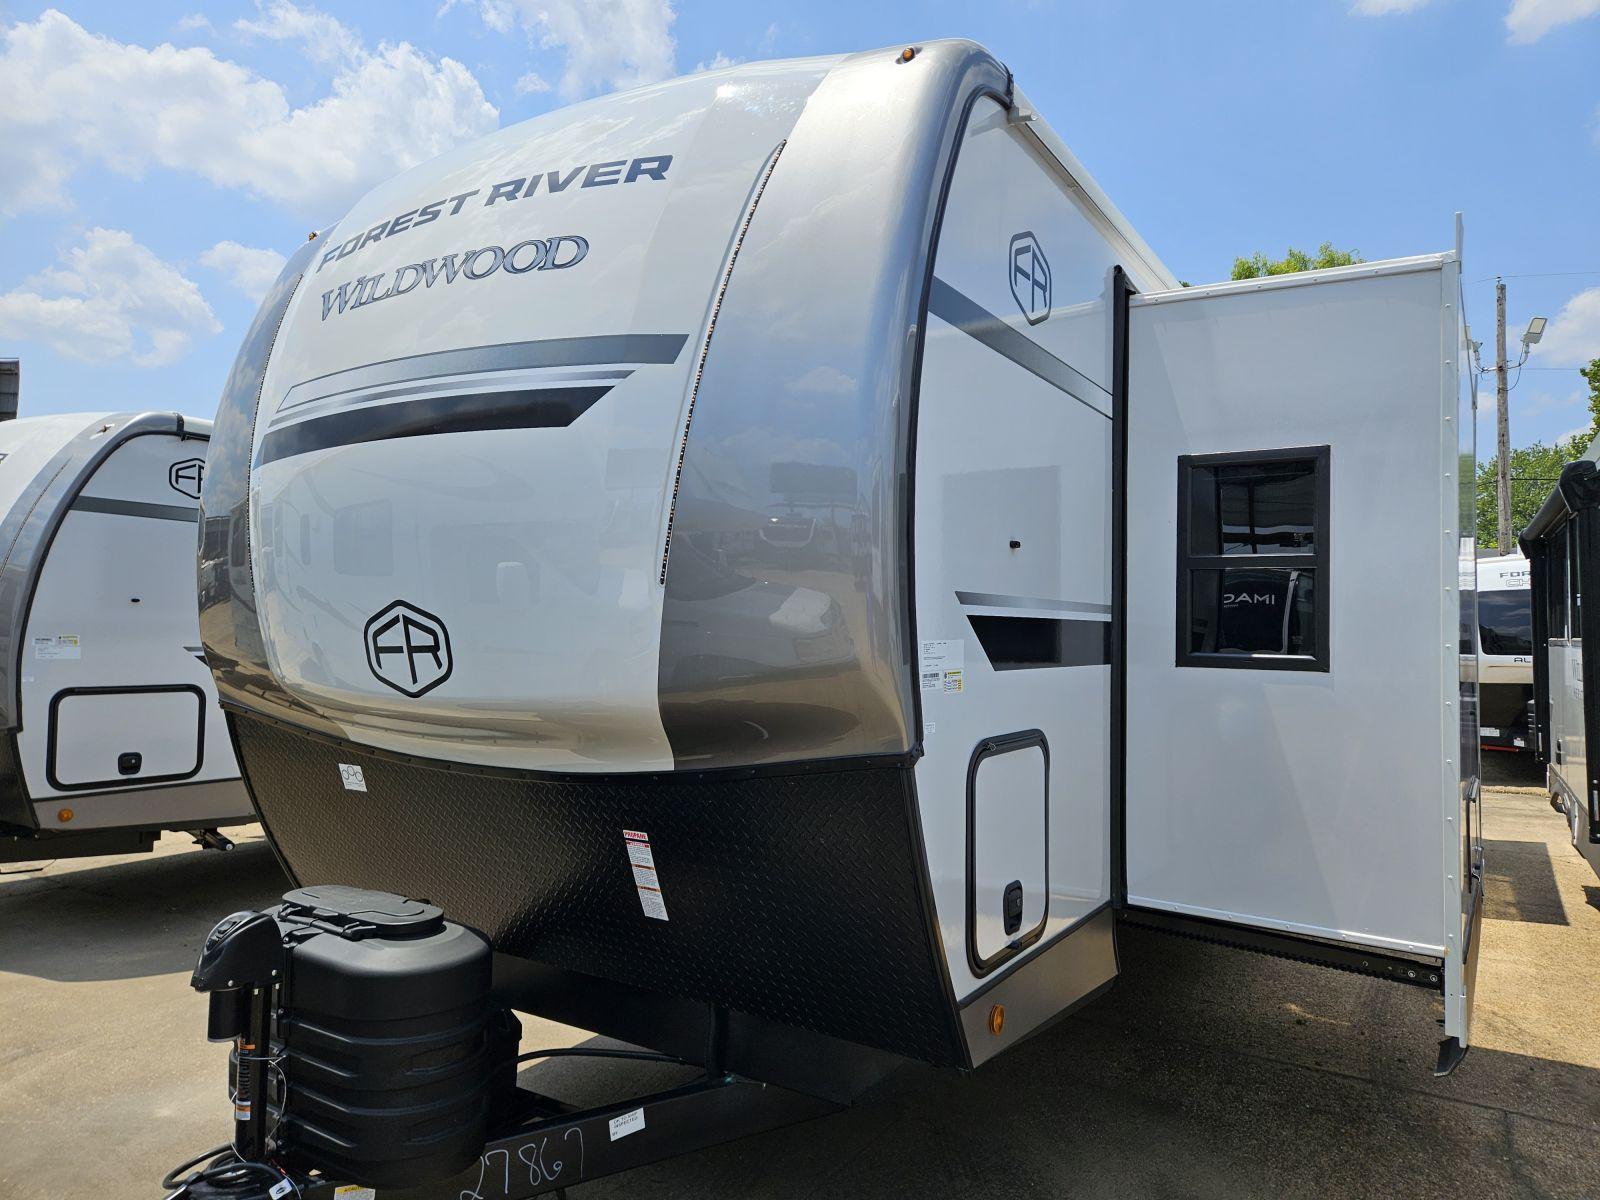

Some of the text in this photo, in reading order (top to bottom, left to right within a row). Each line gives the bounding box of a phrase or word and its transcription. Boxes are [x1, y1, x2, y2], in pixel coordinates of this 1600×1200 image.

[316, 154, 674, 274] FOREST RIVER
[320, 234, 590, 322] WILDWOOD
